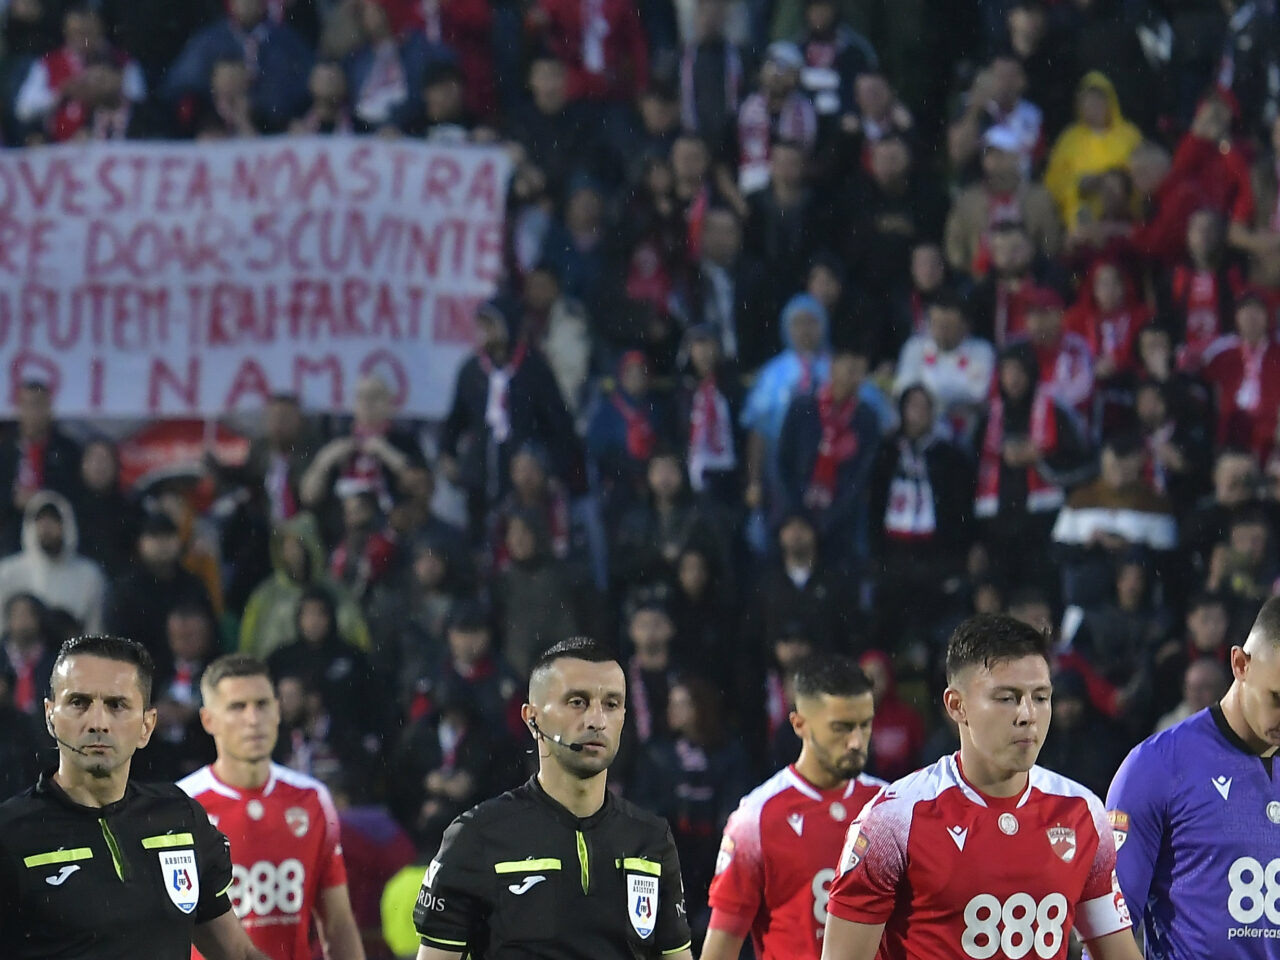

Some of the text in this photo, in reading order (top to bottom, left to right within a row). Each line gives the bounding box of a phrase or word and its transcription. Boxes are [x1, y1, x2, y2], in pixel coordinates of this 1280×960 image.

[233, 147, 497, 210] NOASTRA
[10, 349, 410, 413] DINAMO
[165, 856, 192, 864] ARBITRU
[961, 892, 1068, 960] 888
[1228, 925, 1264, 940] poker
